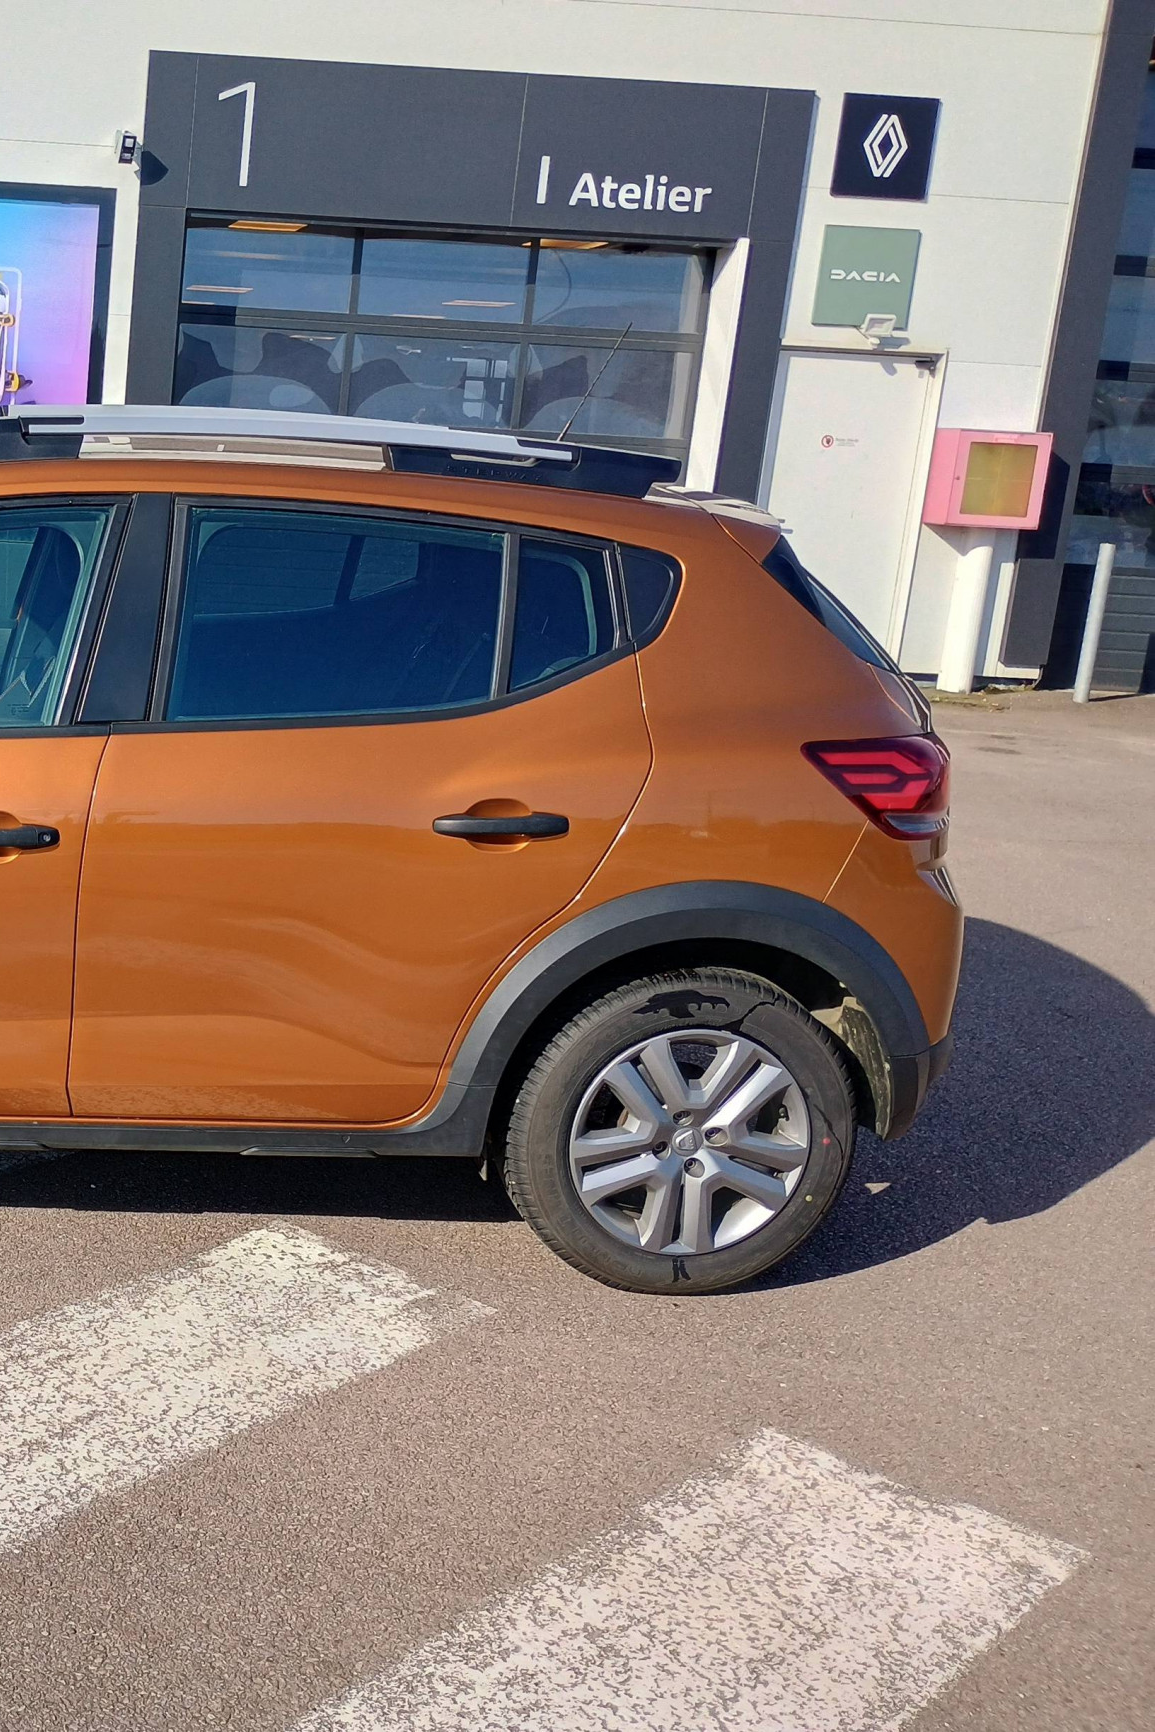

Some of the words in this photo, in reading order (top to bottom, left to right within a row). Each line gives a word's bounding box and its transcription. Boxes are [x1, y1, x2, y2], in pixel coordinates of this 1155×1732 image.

[218, 81, 256, 187] 1
[568, 172, 713, 214] Atelier
[830, 269, 901, 284] DACIA
